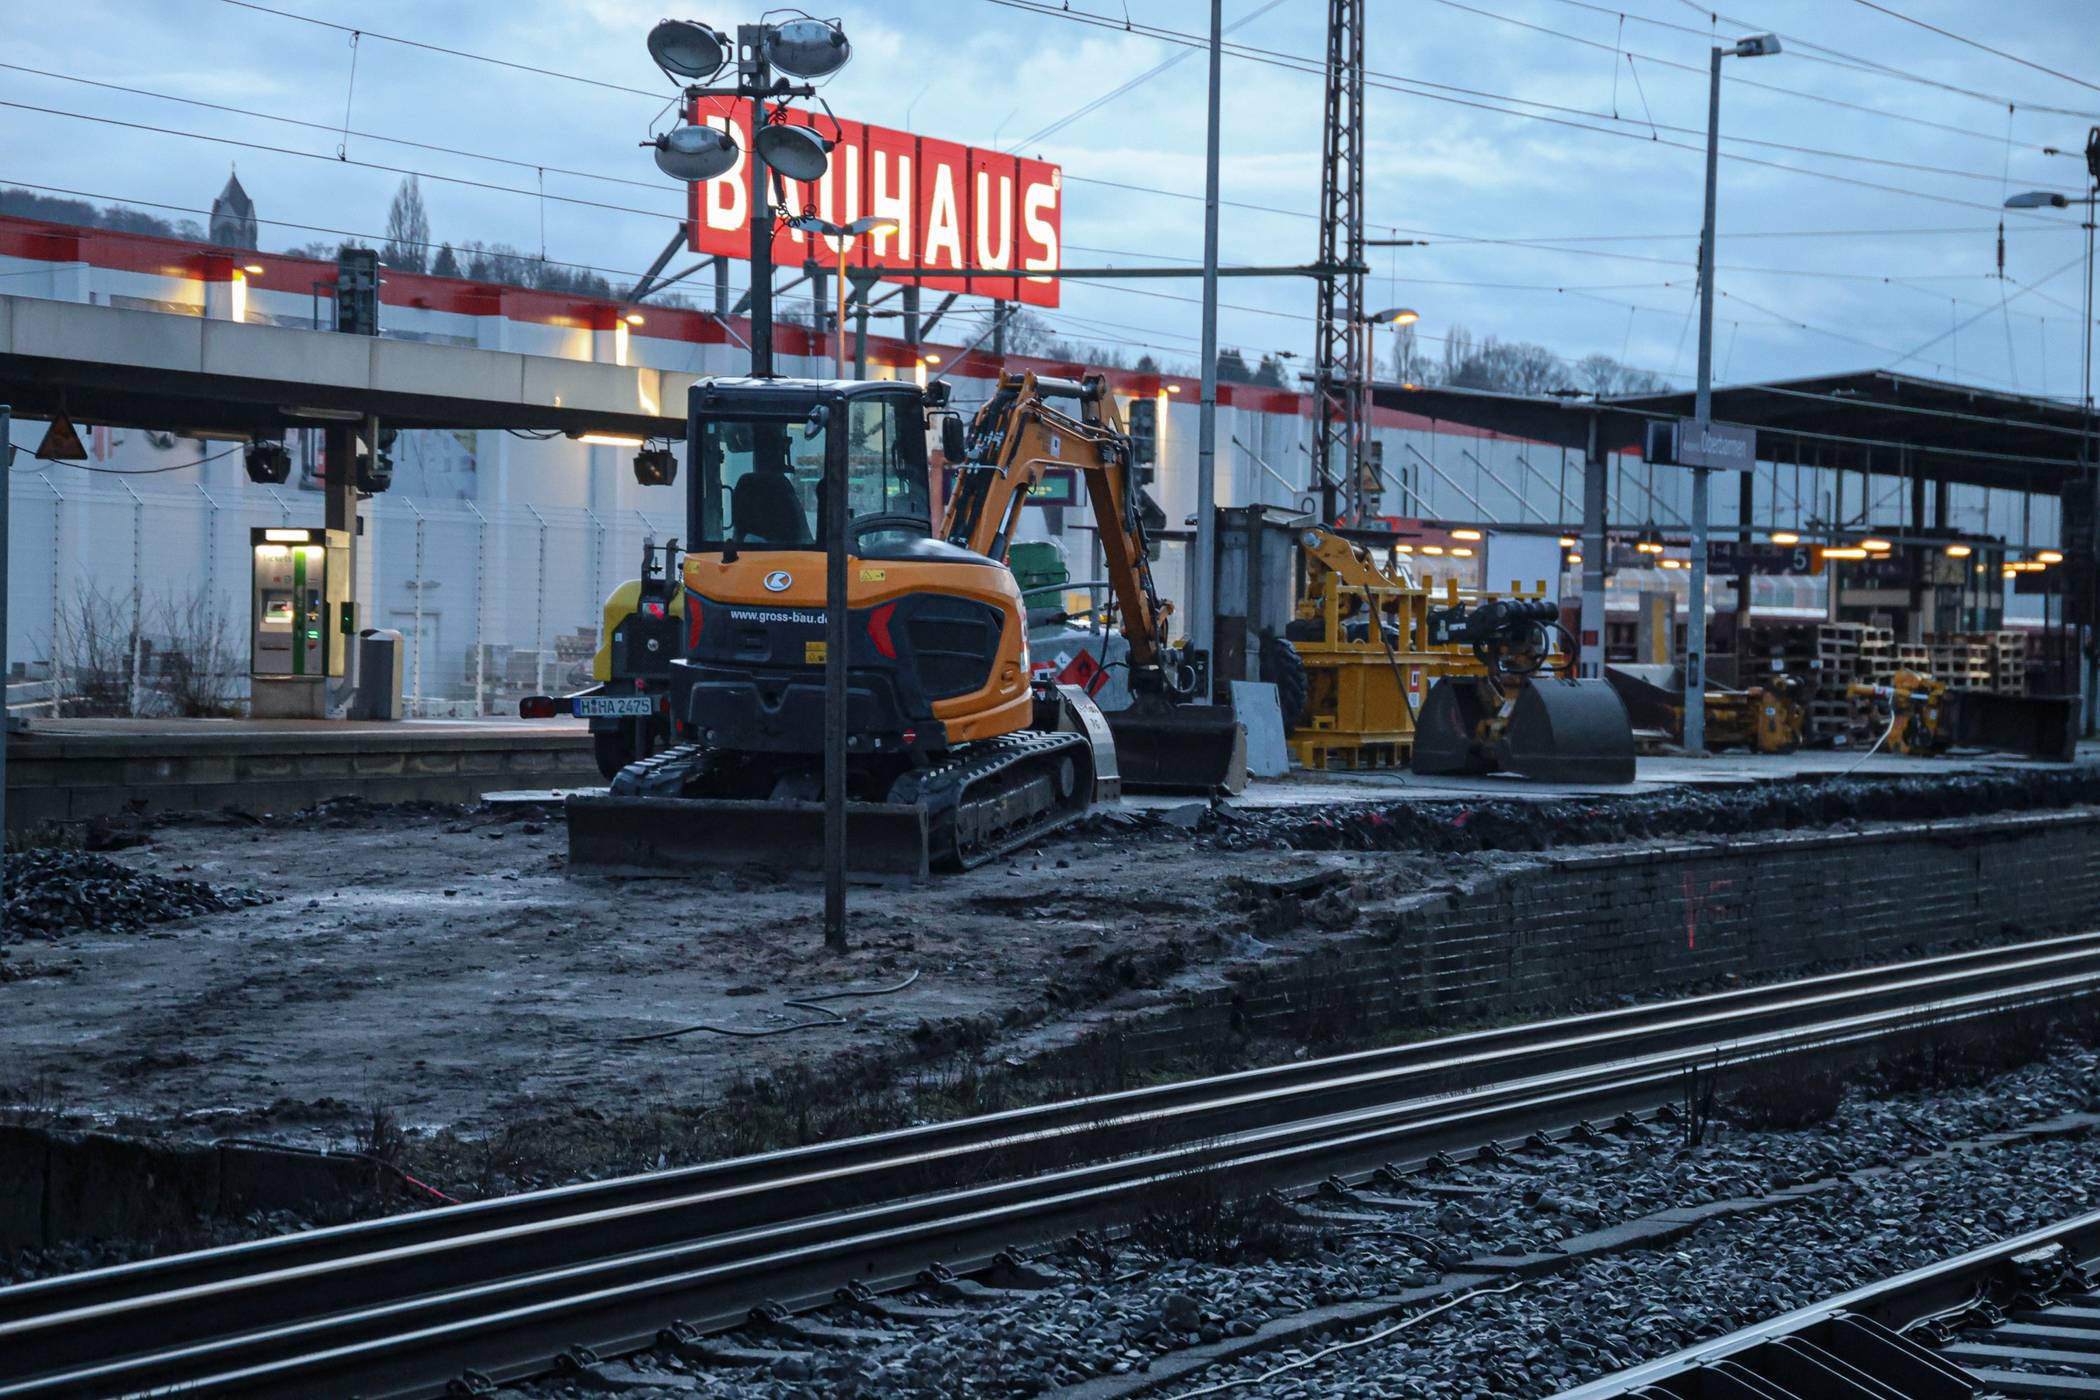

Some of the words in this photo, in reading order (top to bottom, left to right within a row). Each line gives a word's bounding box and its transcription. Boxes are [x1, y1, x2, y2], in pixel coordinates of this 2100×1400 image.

[1793, 548, 1808, 571] 5
[581, 699, 591, 714] H
[598, 699, 616, 714] HA
[617, 699, 650, 714] 2475
